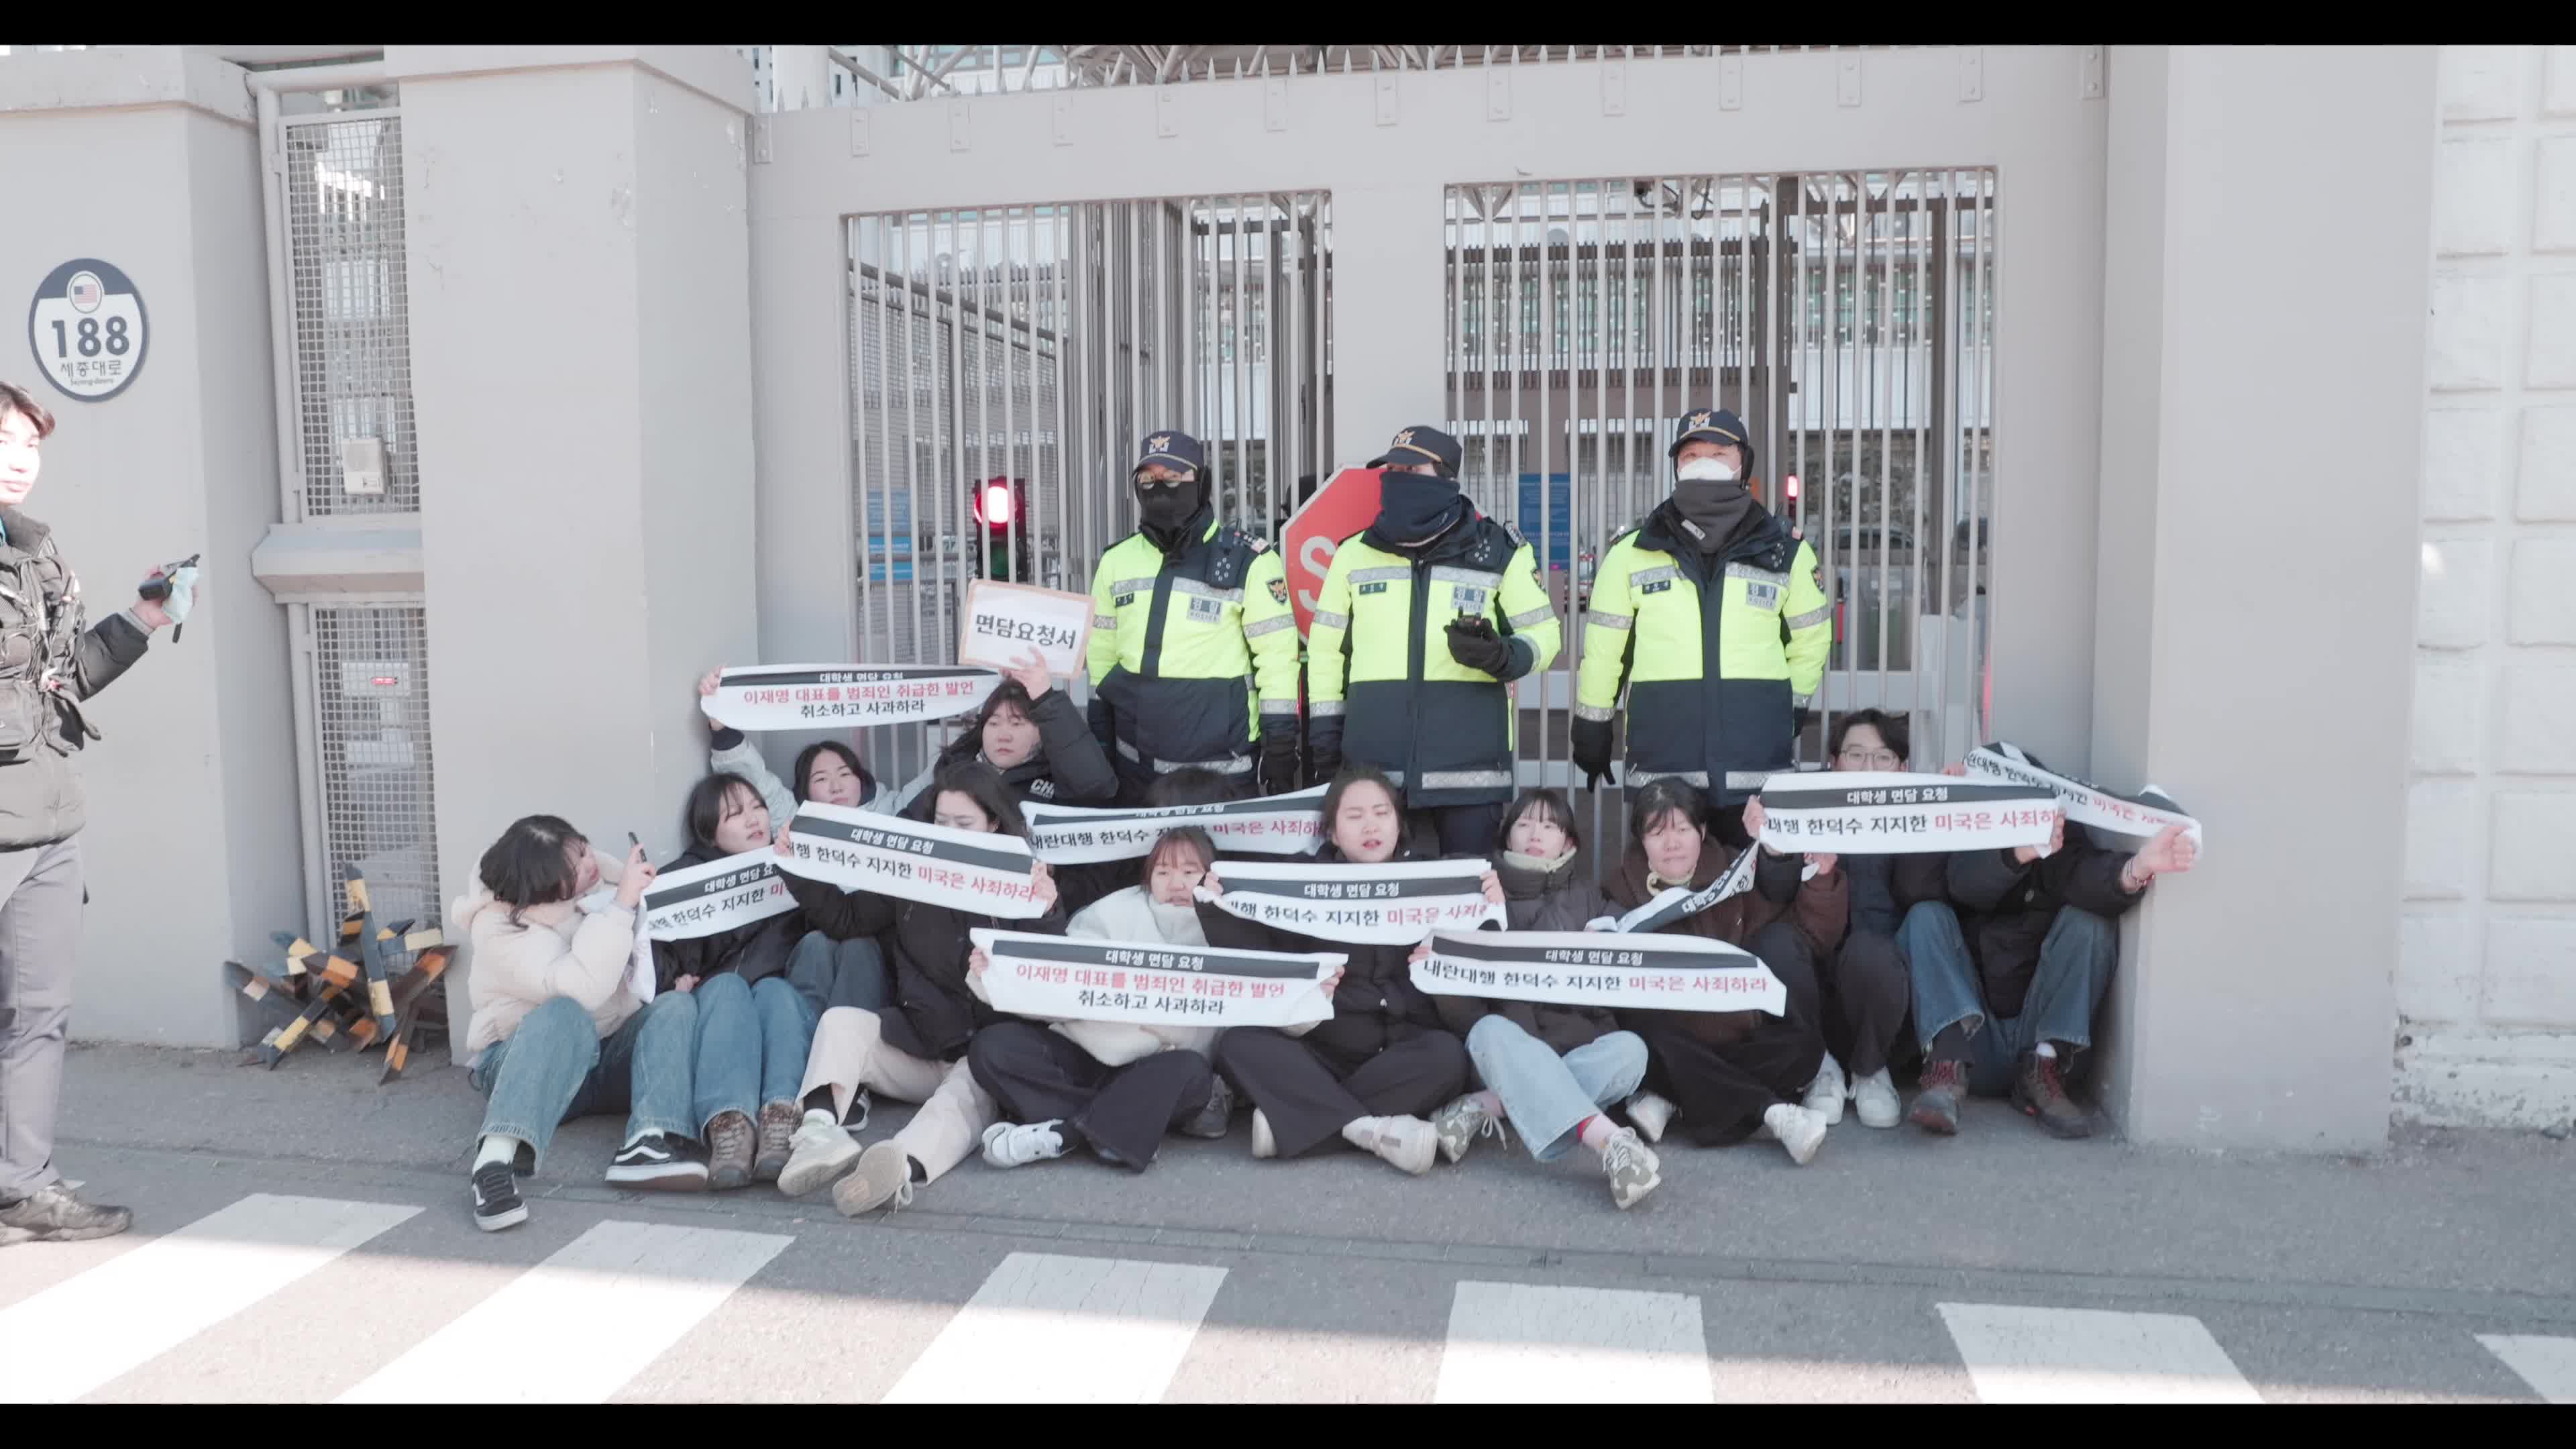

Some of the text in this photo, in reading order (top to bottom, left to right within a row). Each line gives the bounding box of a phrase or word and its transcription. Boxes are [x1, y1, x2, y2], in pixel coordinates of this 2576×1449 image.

[52, 315, 129, 358] 188
[60, 360, 121, 377] 세종대로
[975, 613, 1077, 649] 면담요청서
[744, 680, 974, 704] 이재명 대표를 범죄인 취급한 발언
[800, 698, 925, 718] 취소하고 사과하라
[1847, 787, 1948, 804] 대학생 면담 요청
[1213, 822, 1265, 835] 미국은
[1807, 816, 1863, 835] 한덕수
[1870, 814, 1927, 833] 지지한
[1935, 812, 1992, 830] 미국은
[851, 828, 934, 855] 대학생 면담 요청
[1030, 830, 1093, 850] 내란대행
[1099, 828, 1148, 845] 한덕수
[704, 874, 737, 893] 대학생
[739, 868, 761, 884] 면담
[816, 845, 862, 869] 한덕수
[866, 856, 913, 879] 지지한
[918, 865, 966, 890] 미국은
[971, 876, 1037, 902] 사죄하라
[1303, 882, 1399, 898] 대학생 면담 요청
[672, 904, 716, 926] 한덕수
[721, 887, 765, 911] 지지한
[1325, 909, 1379, 926] 지지한
[1387, 907, 1440, 925] 미국은
[1106, 949, 1204, 971] 대학생 면담 요청
[1545, 949, 1643, 966] 대학생 면담 요청
[1016, 965, 1285, 999] 이재명 대표를 범죄인 취급한 발언
[1424, 960, 1768, 993] 내란대행 한덕수 지지한 미국은 사죄하라
[1078, 989, 1224, 1015] 취소하고 사과하라
